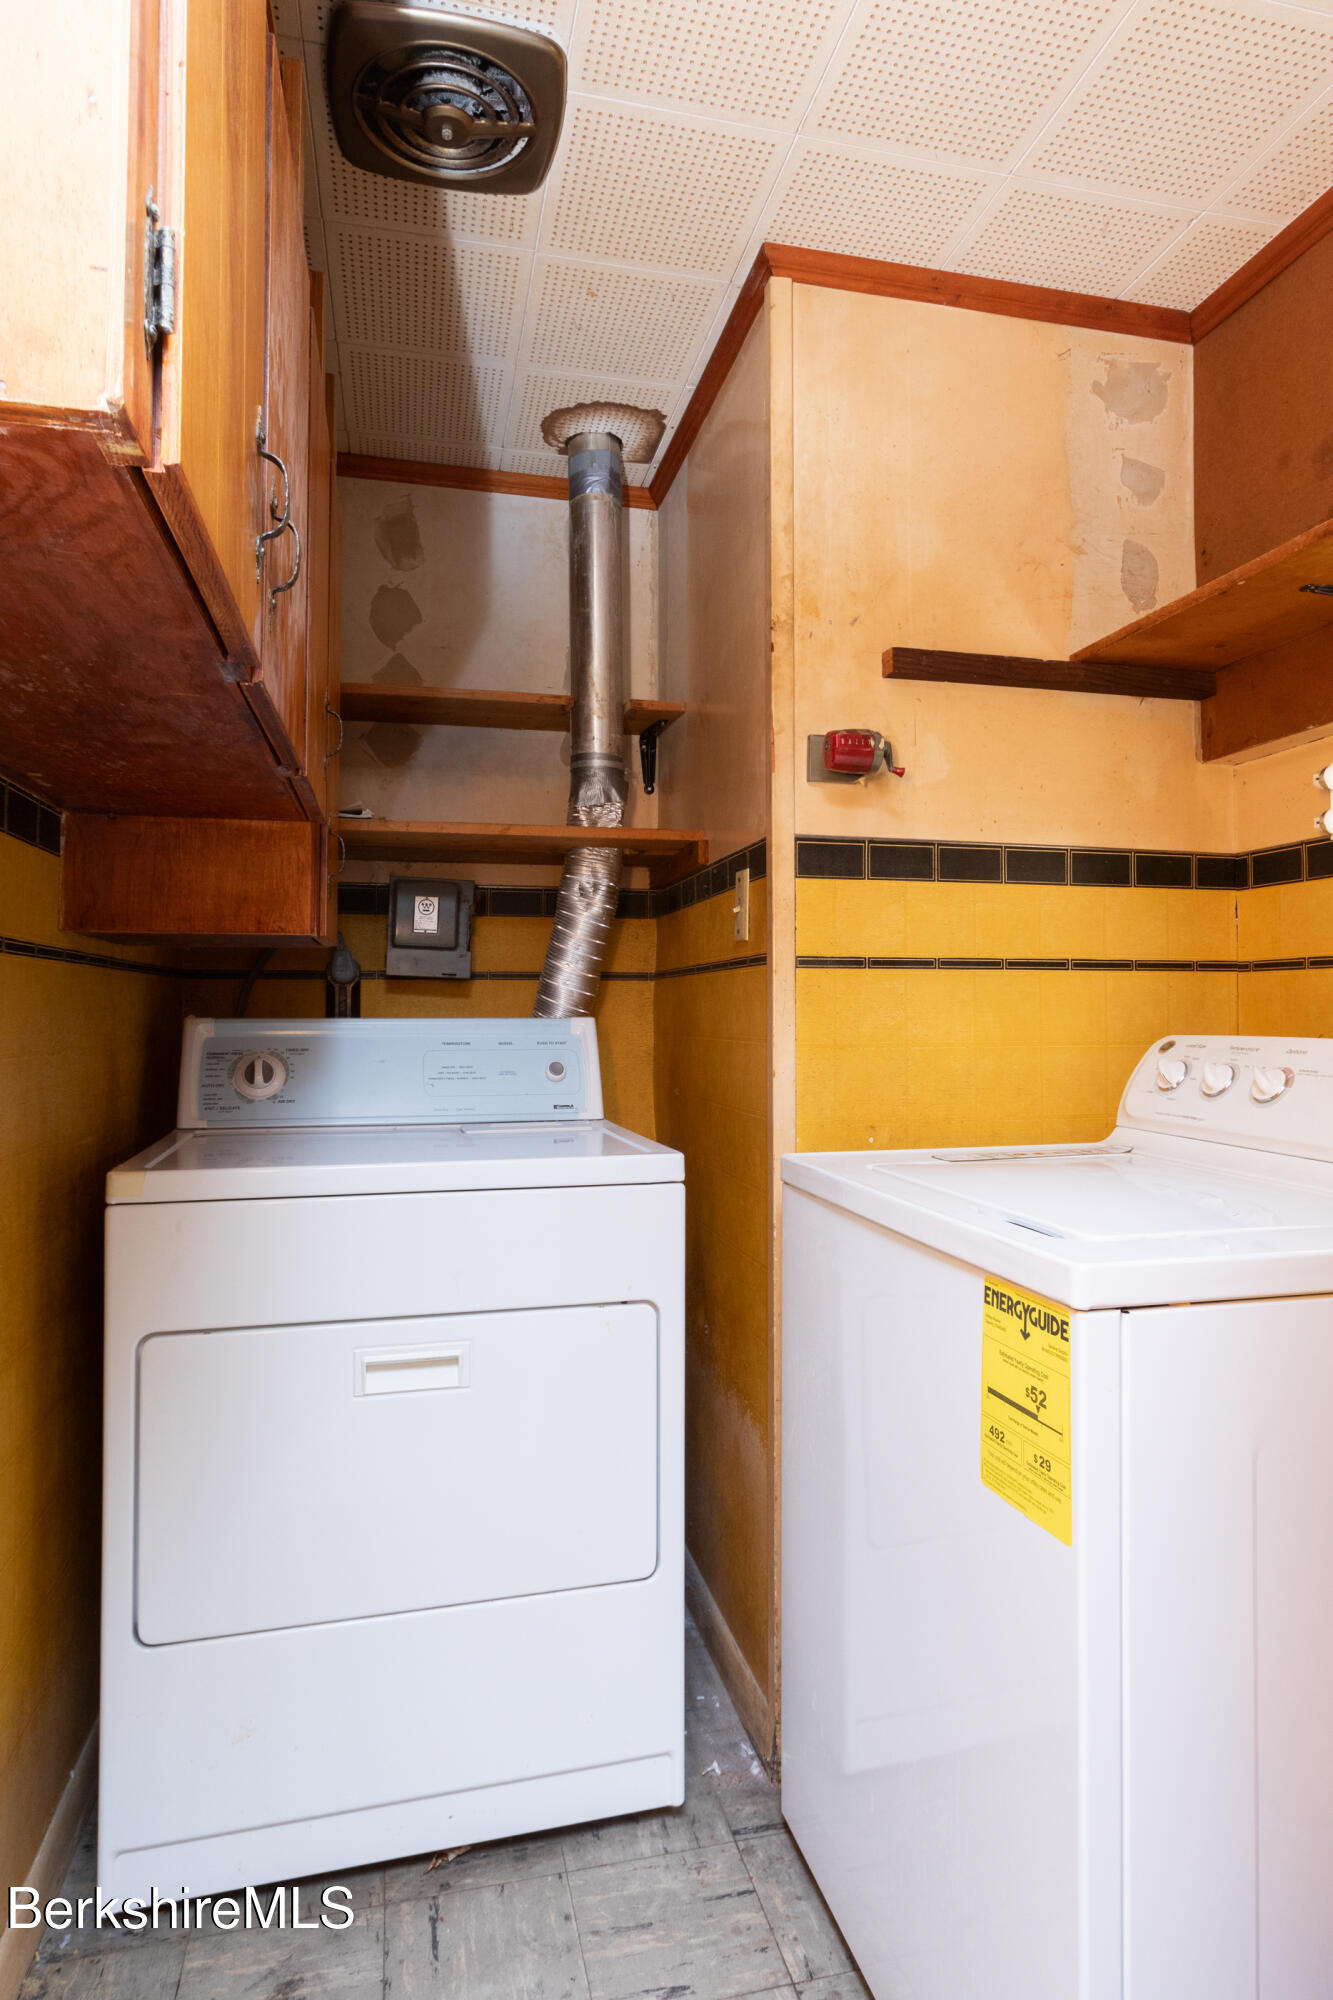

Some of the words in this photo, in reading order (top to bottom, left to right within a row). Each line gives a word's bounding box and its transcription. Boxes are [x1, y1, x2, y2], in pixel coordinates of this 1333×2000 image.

[984, 1285, 1069, 1342] ENERGYGUIDE
[1025, 1385, 1047, 1410] $52
[989, 1425, 1005, 1443] 492
